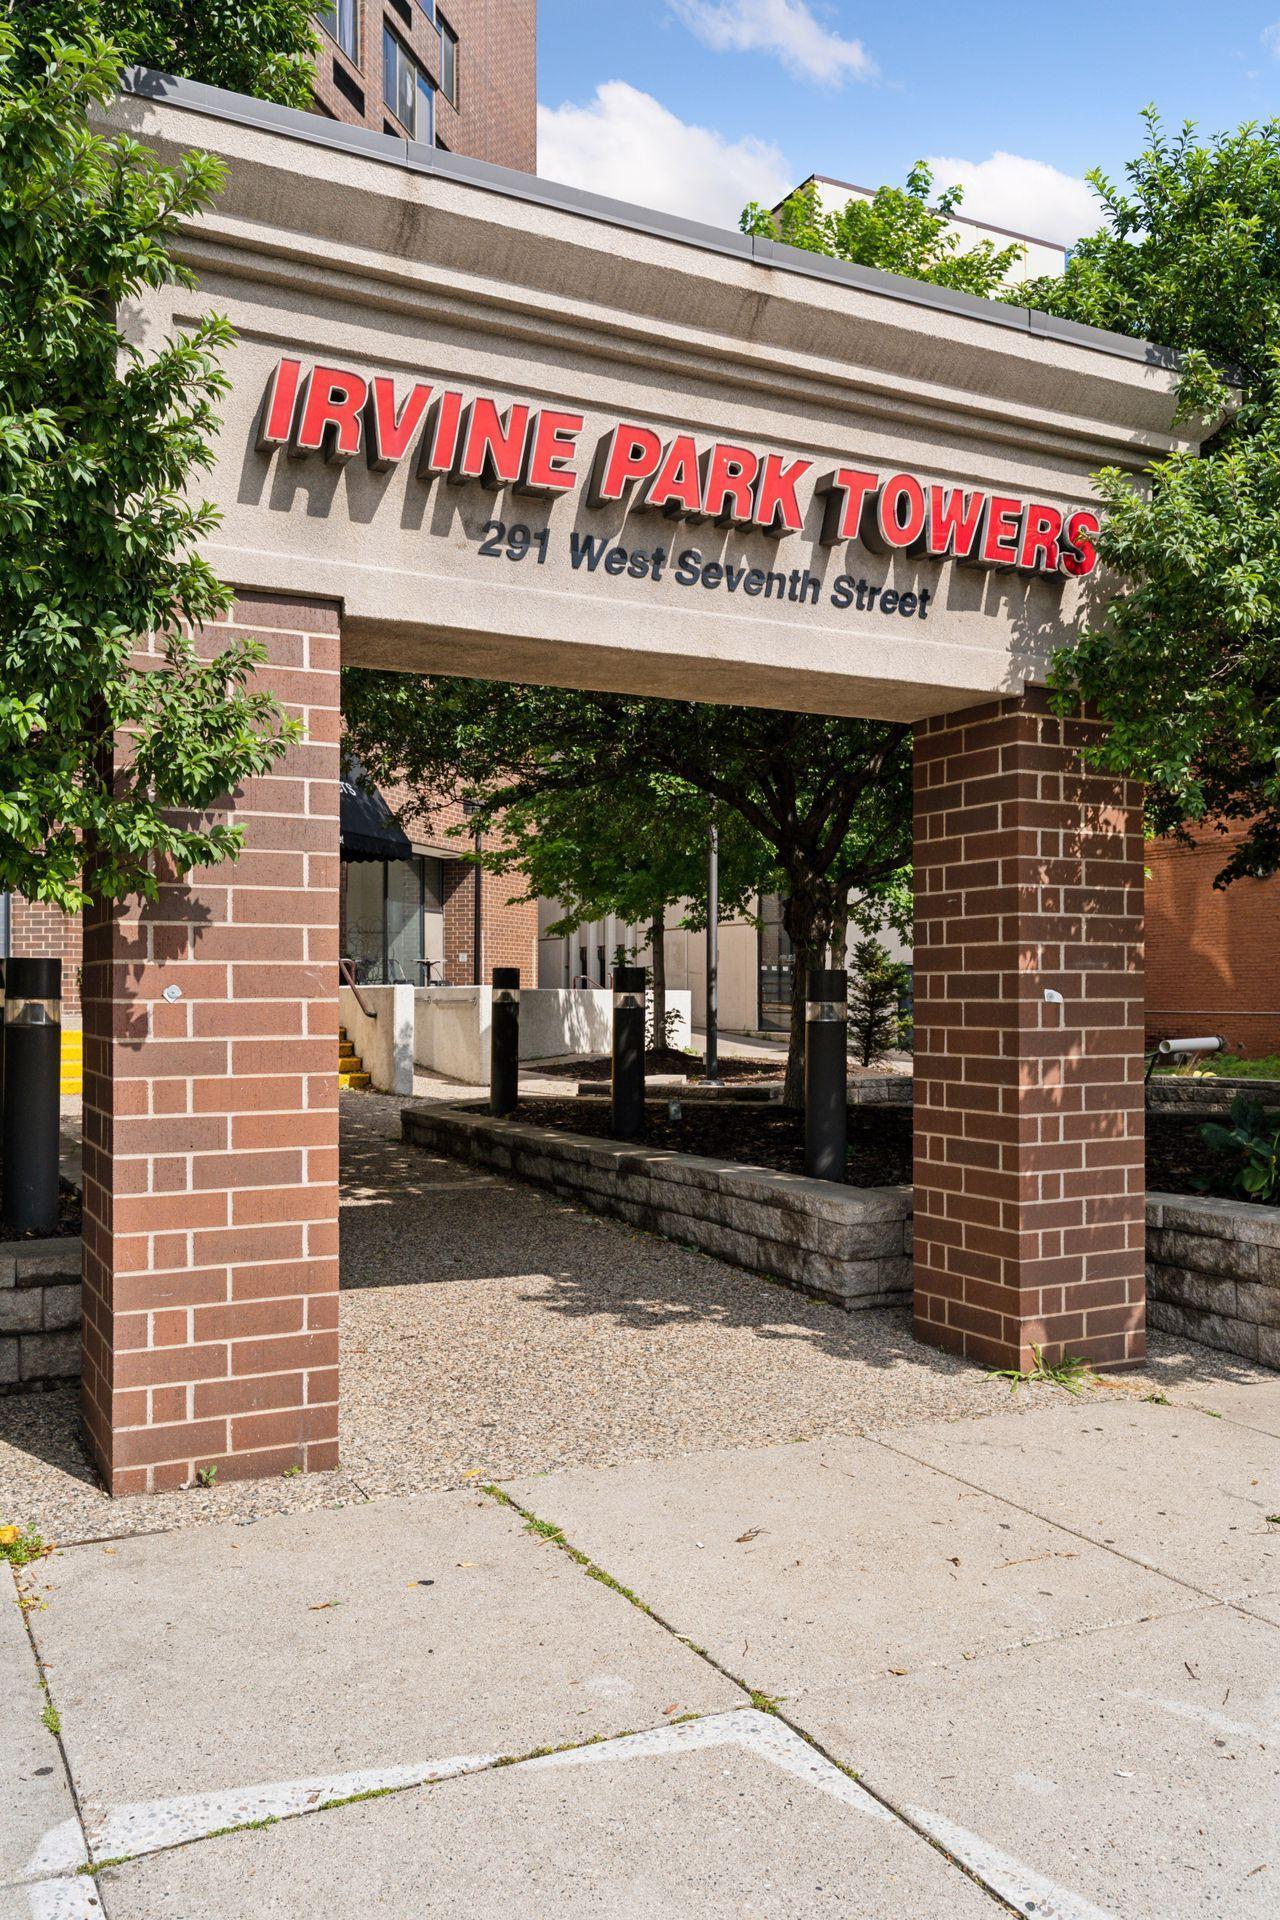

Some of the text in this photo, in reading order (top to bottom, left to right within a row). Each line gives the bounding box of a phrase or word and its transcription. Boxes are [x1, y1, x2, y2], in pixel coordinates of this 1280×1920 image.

[263, 356, 1100, 577] IRVINE PARK TOWERS
[478, 520, 931, 620] 291 West Seventh Street
